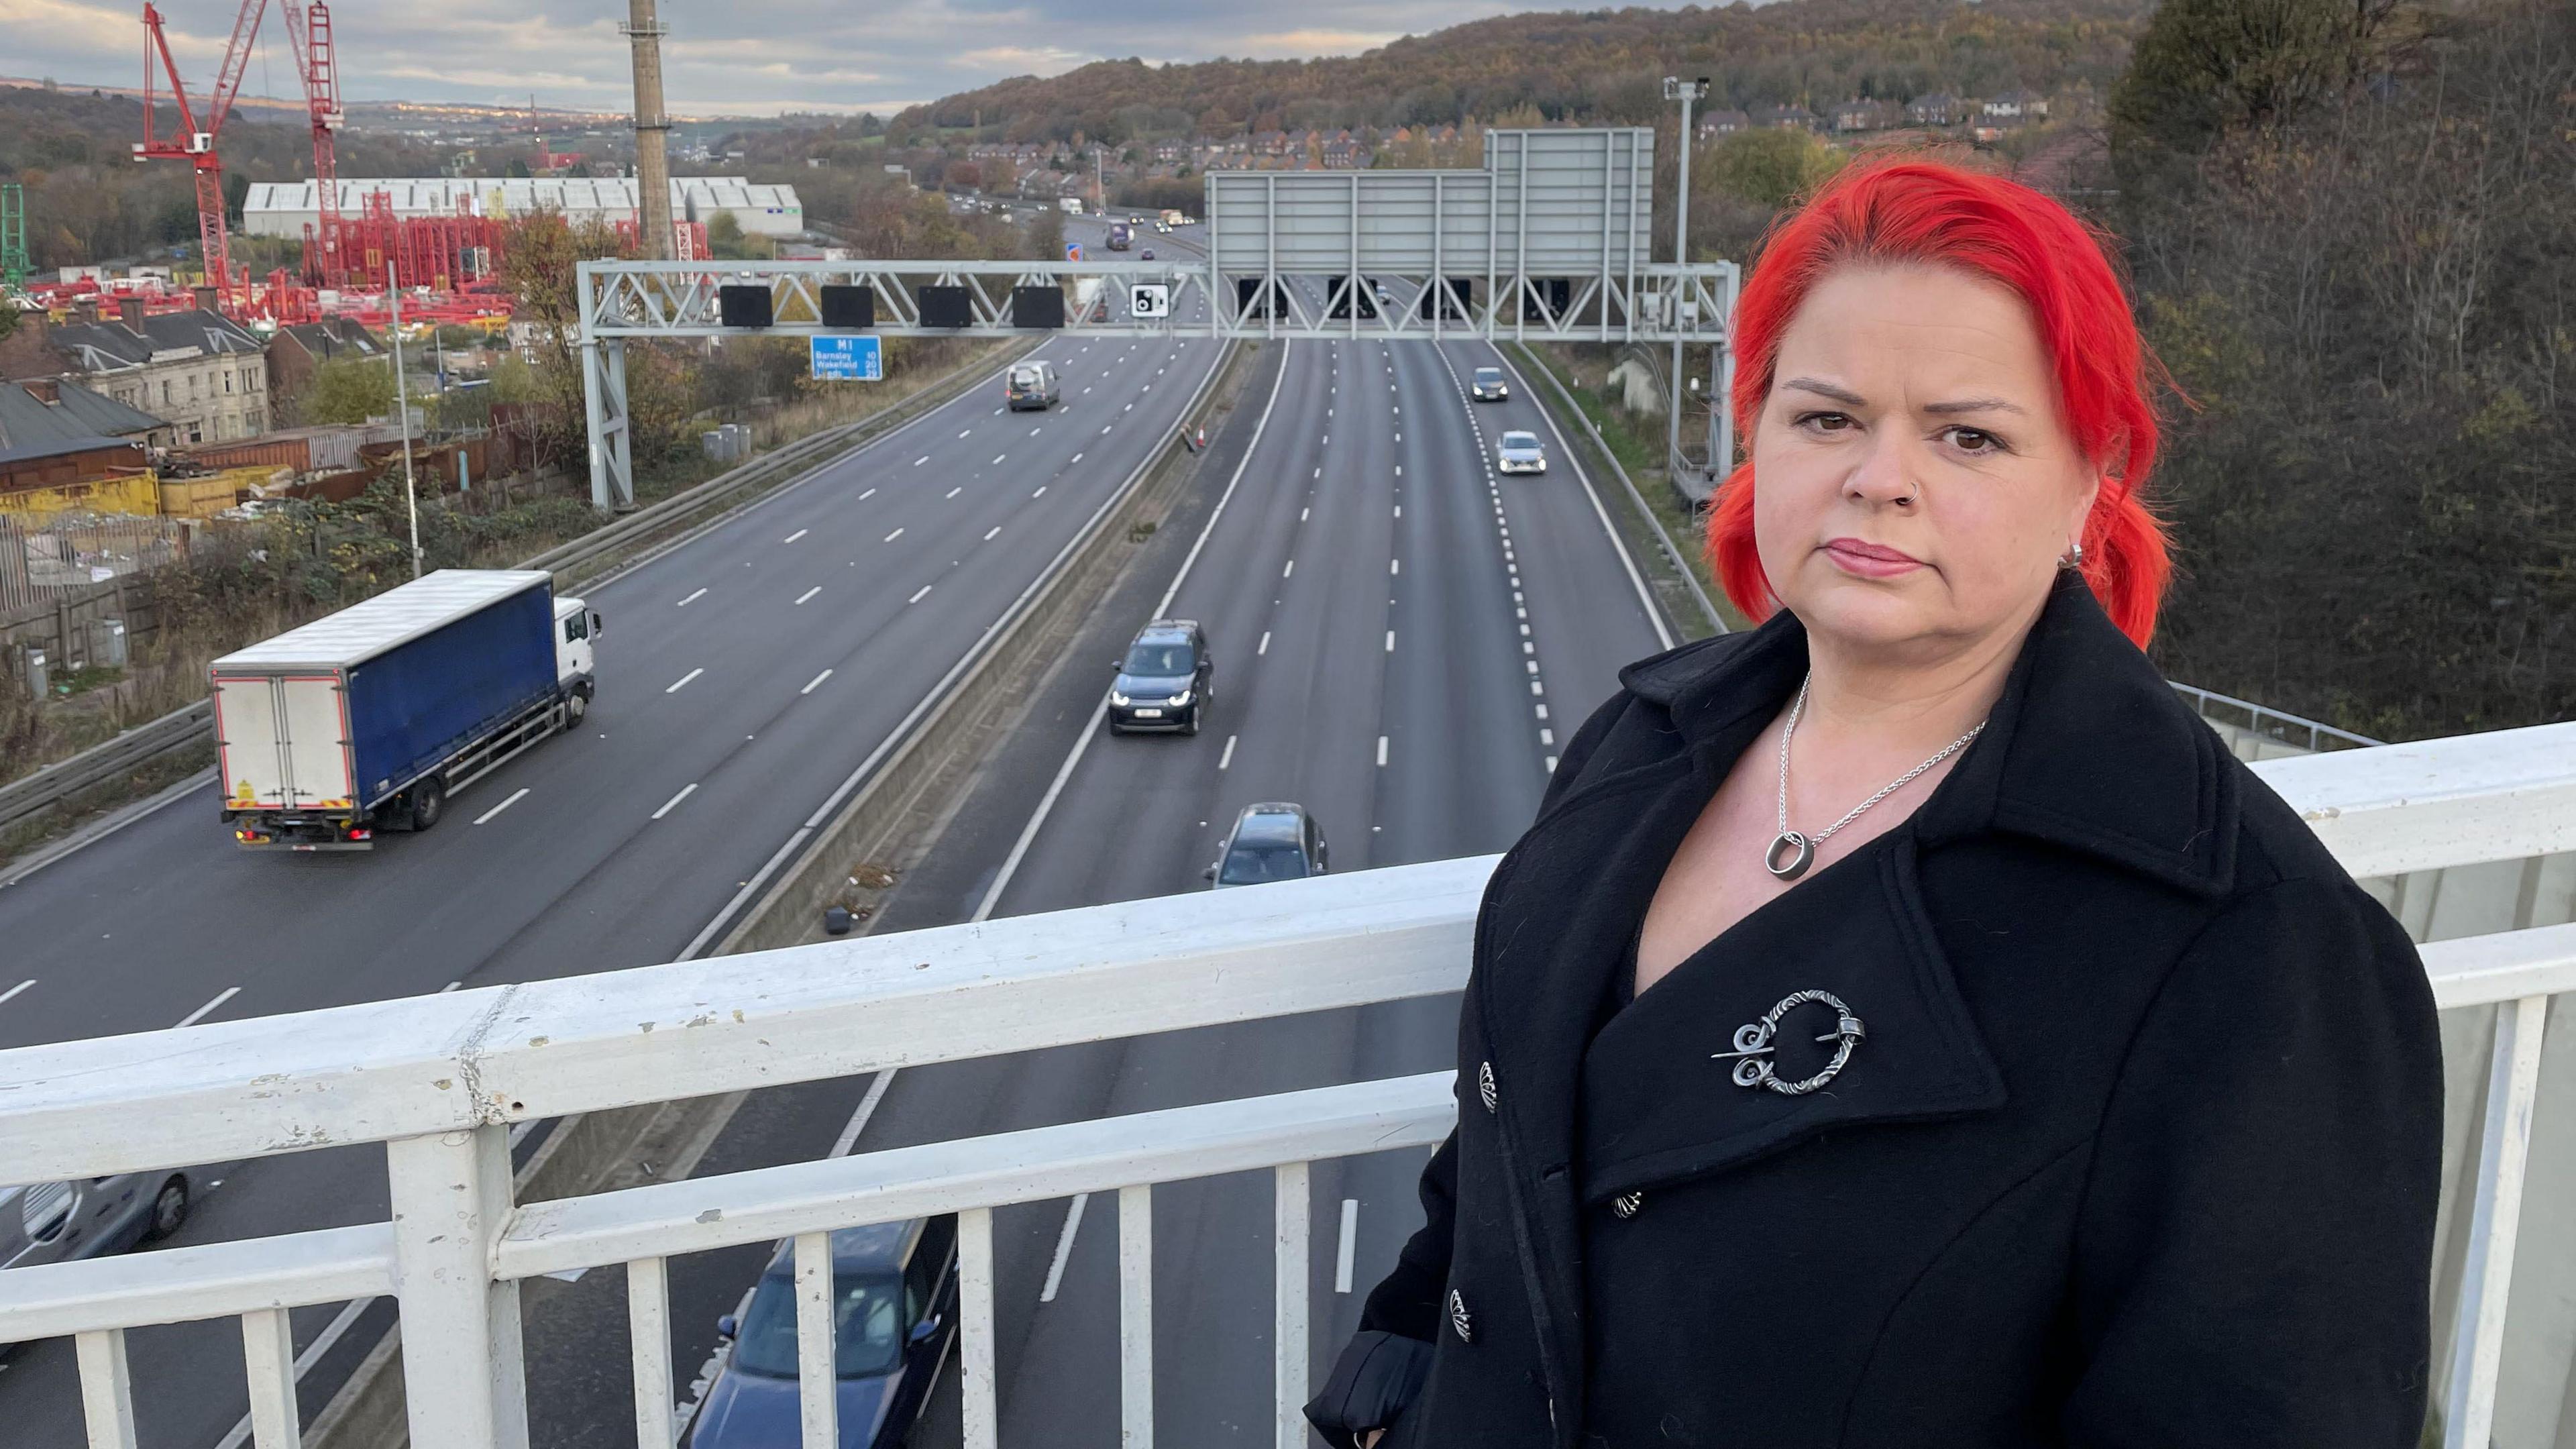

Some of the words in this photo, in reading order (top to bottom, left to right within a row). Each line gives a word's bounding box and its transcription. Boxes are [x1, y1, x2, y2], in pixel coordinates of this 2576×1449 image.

[816, 351, 851, 361] Barnsley
[816, 360, 857, 368] Wakefield
[865, 360, 877, 368] 20
